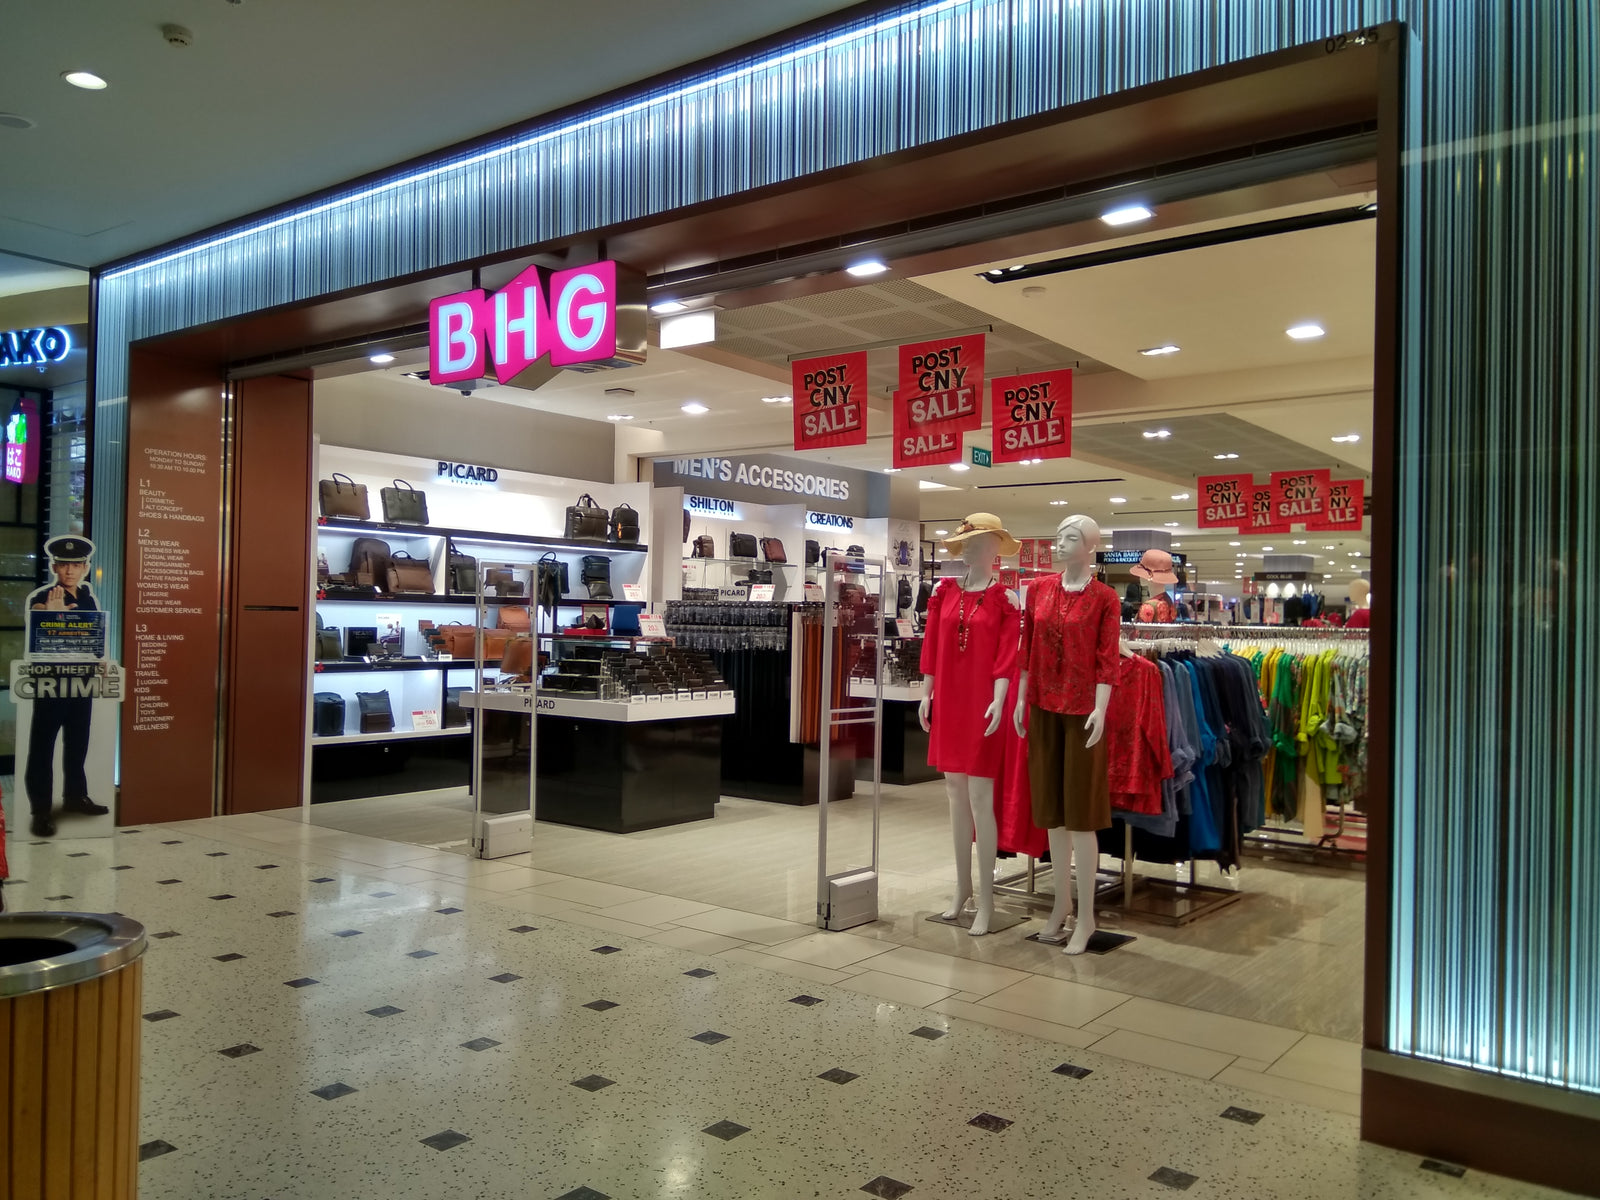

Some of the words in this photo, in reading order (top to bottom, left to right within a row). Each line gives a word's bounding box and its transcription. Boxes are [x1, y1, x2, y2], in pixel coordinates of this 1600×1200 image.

[1325, 28, 1378, 54] 02-45
[438, 273, 607, 375] BHG
[912, 345, 962, 374] POST
[804, 364, 848, 390] POST
[918, 366, 968, 392] CNY
[810, 384, 853, 408] CNY
[1004, 381, 1052, 406] POST
[912, 388, 972, 423] SALE
[1010, 400, 1058, 422] CNY
[804, 405, 858, 436] SALE
[1004, 420, 1062, 450] SALE
[904, 434, 954, 456] SALE
[974, 450, 986, 464] EXIT
[438, 462, 498, 482] PICARD
[673, 458, 732, 482] MEN'S
[734, 462, 850, 500] ACCESSORIES
[140, 478, 150, 487] L1
[1206, 480, 1238, 494] POST
[1280, 475, 1314, 488] POST
[1210, 492, 1242, 504] CNY
[1285, 486, 1318, 499] CNY
[1329, 486, 1349, 496] ST
[690, 496, 734, 512] SHILTON
[1252, 502, 1270, 512] CN
[1279, 498, 1322, 517] SALE
[1330, 497, 1352, 508] NY
[169, 514, 205, 522] HANDBAGS
[810, 512, 854, 528] CREATIONS
[1206, 503, 1246, 521] SALE
[1328, 508, 1355, 523] ALE
[138, 529, 150, 537] L2
[136, 624, 147, 632] L3
[18, 665, 51, 675] SHOP
[56, 665, 90, 674] THEFT
[94, 665, 105, 674] IS
[109, 665, 118, 674] A
[14, 677, 120, 699] CRIME
[524, 698, 555, 709] PIARD
